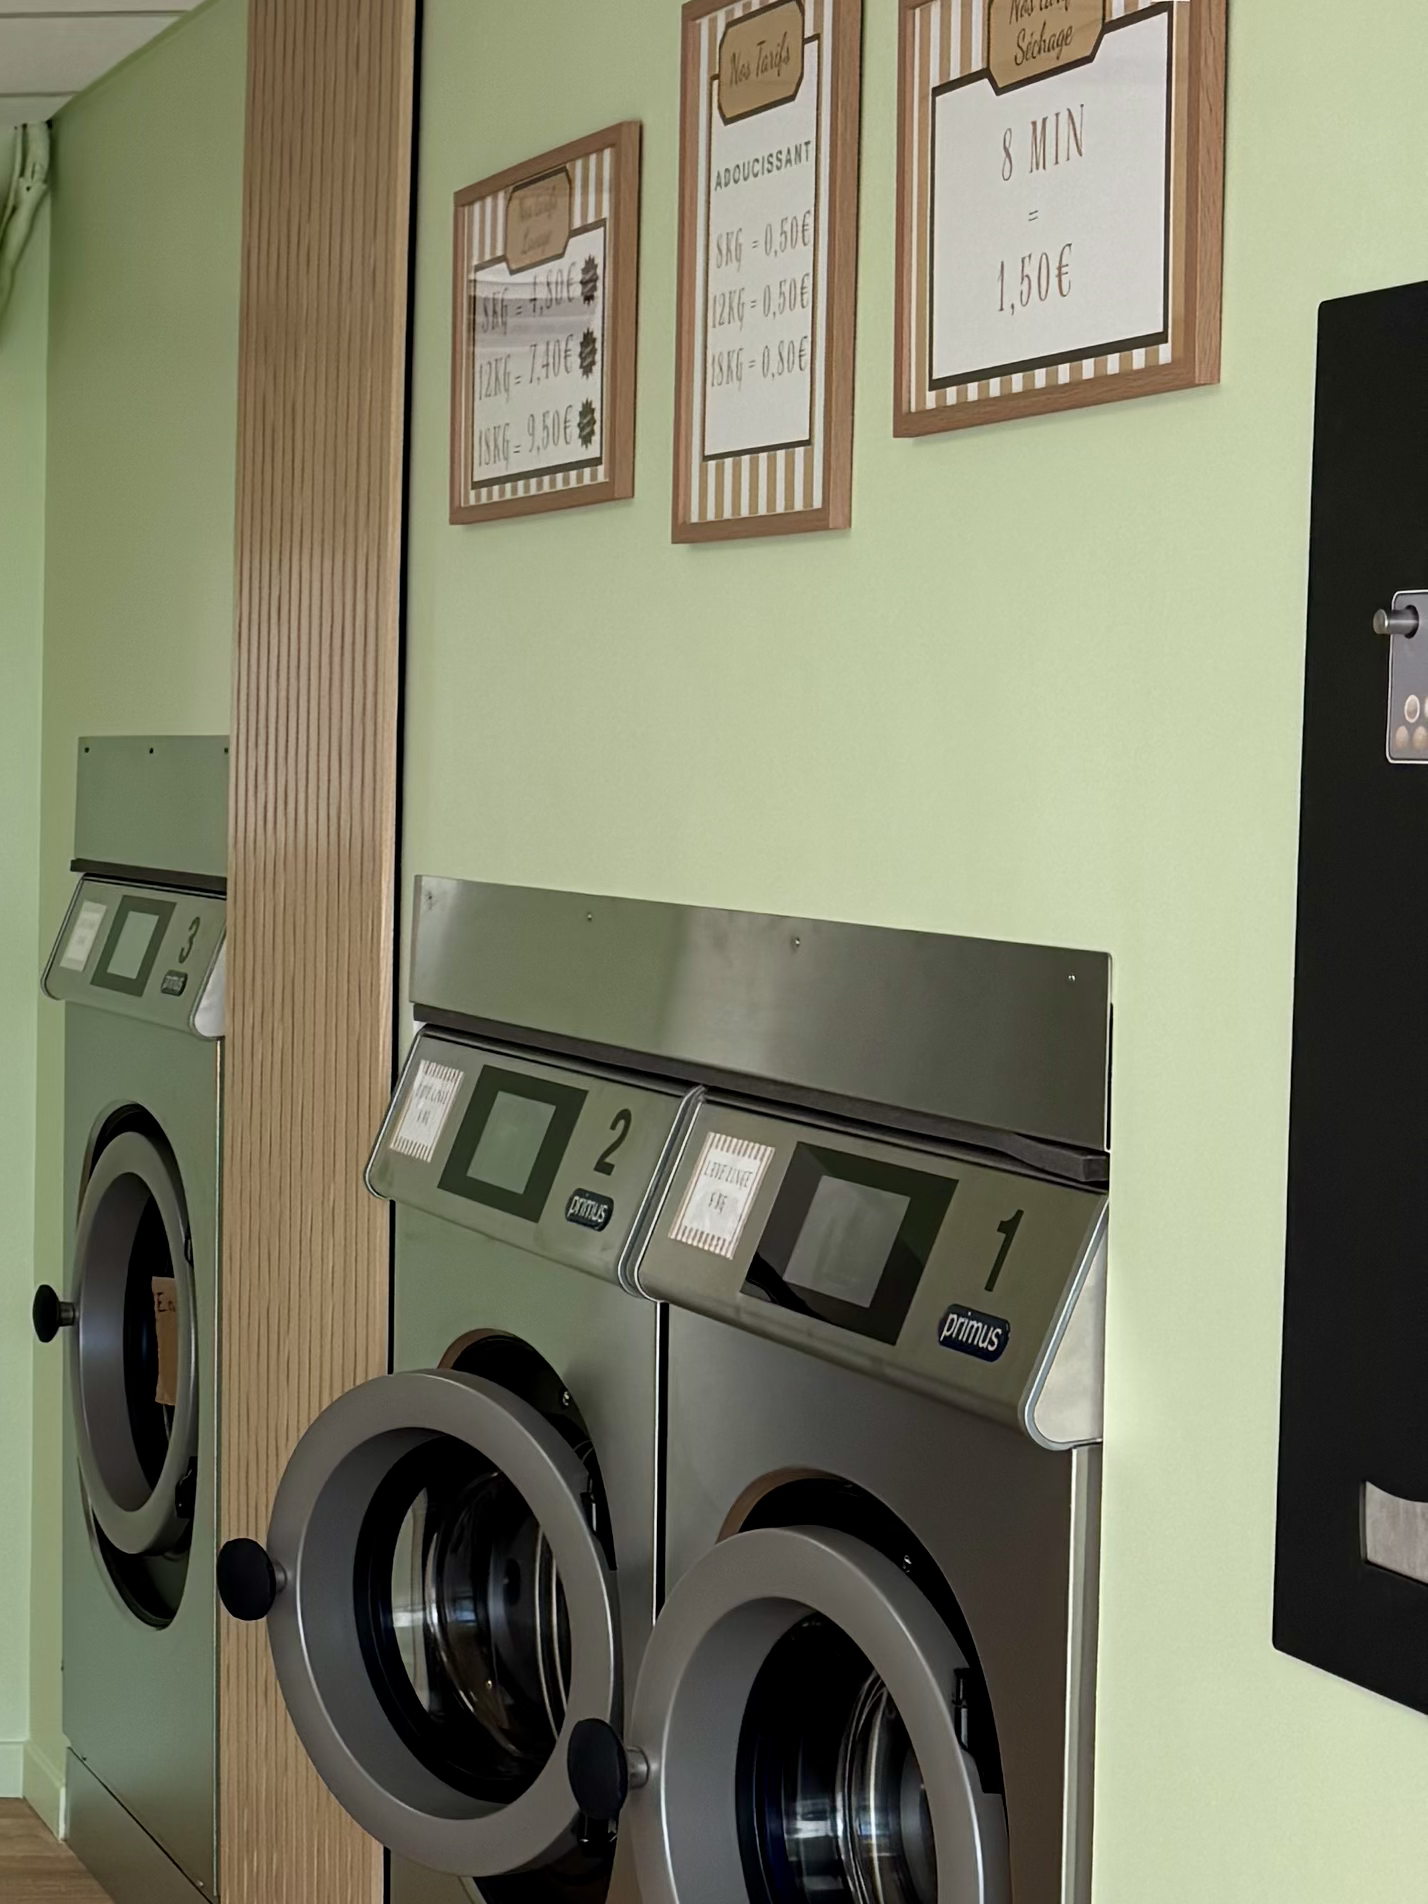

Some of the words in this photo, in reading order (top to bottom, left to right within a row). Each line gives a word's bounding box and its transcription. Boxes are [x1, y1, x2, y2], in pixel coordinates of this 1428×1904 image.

[730, 52, 751, 86] Nos
[756, 31, 790, 78] Tarifs
[1014, 20, 1073, 66] Séchage
[714, 140, 811, 192] ADOUCISSANT
[1002, 127, 1013, 181] 8
[1029, 104, 1084, 174] MIN
[716, 228, 742, 272] 8KG
[764, 210, 811, 258] 0,50€
[712, 288, 745, 331] 12KG
[763, 273, 809, 320] 0,50€
[997, 243, 1072, 316] 1,50€
[479, 353, 511, 403] 12KG
[711, 347, 744, 392] 18KG
[762, 336, 808, 380] 0,80€
[527, 404, 572, 455] 9,50€
[178, 916, 201, 964] 3
[593, 1108, 632, 1176] 2
[567, 1193, 608, 1223] primus
[984, 1209, 1024, 1292] 1
[940, 1311, 1002, 1351] primus
